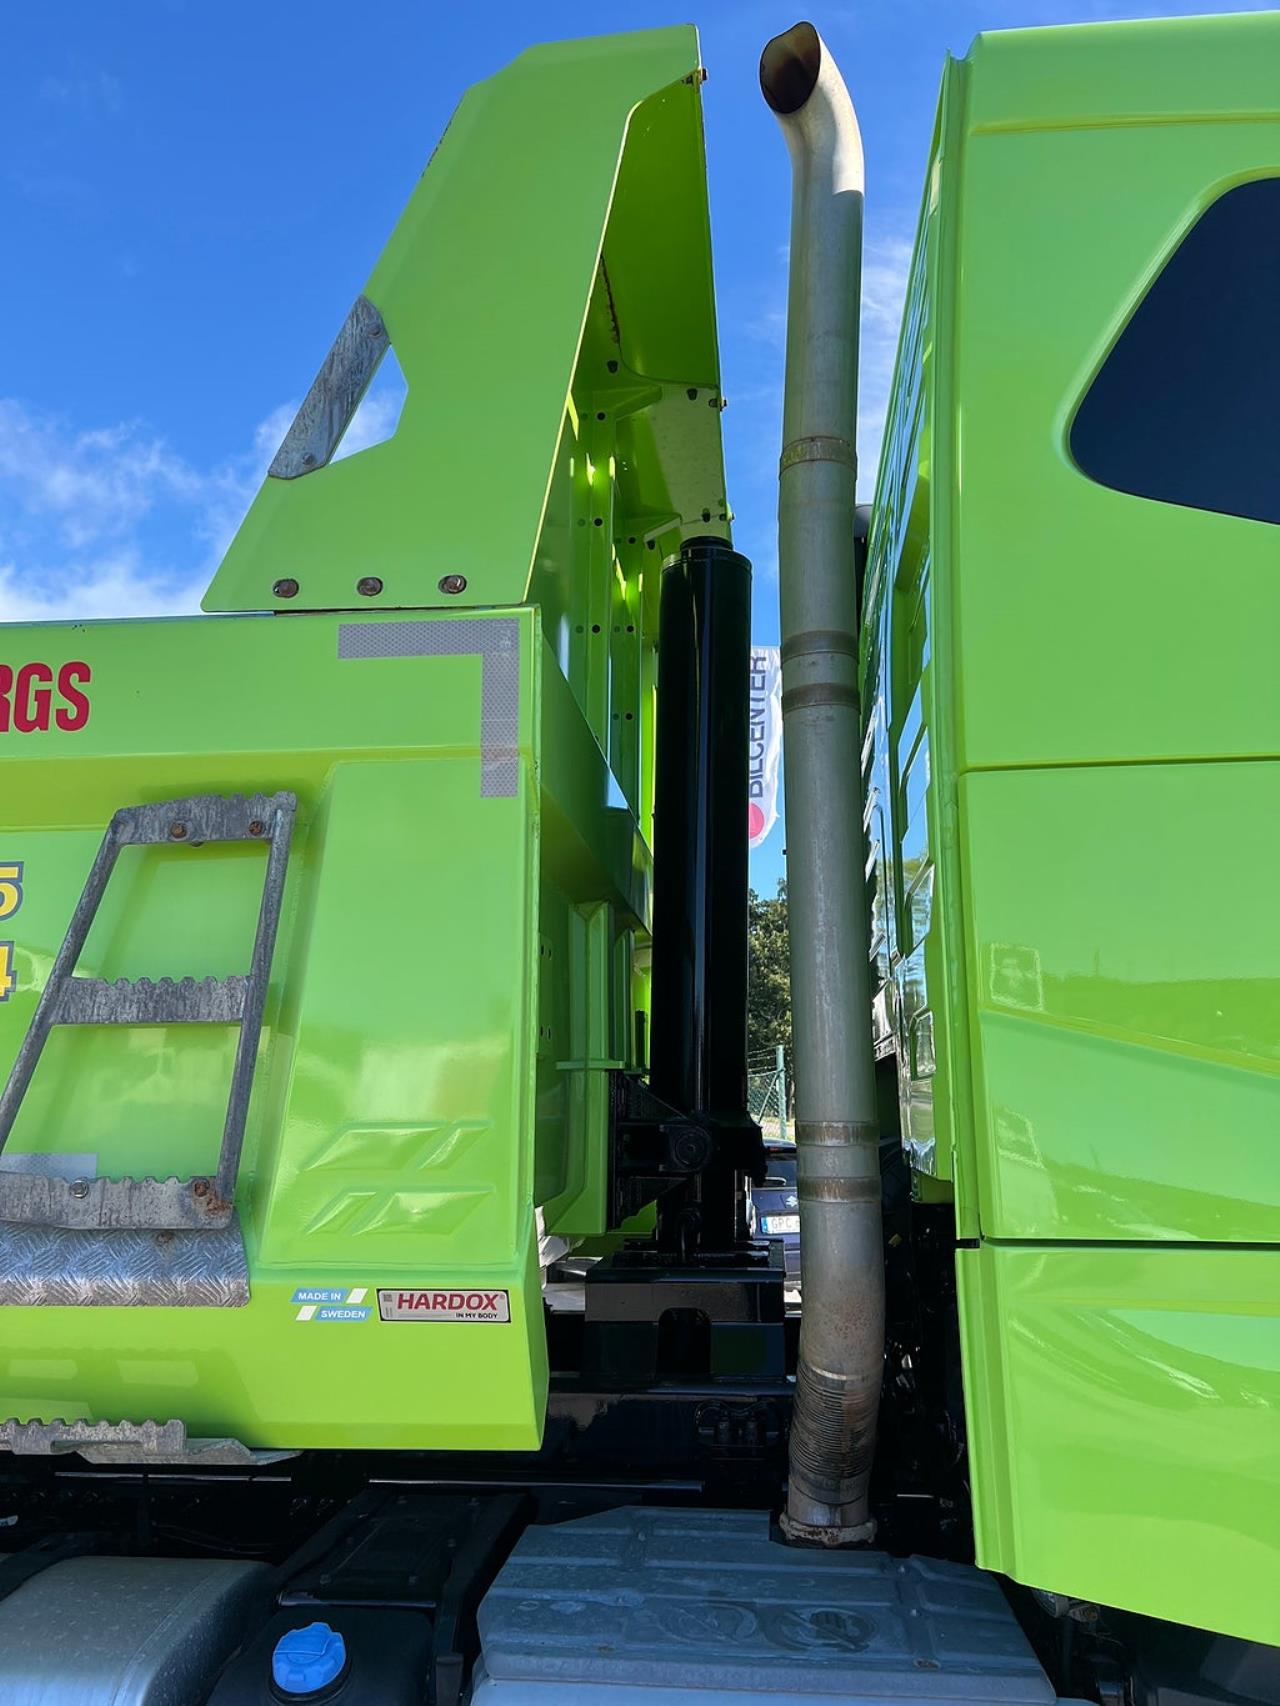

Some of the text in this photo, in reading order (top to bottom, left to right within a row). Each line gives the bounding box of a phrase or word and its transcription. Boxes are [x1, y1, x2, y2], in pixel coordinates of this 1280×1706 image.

[298, 1292, 342, 1300] MADE IN
[397, 1292, 499, 1311] HARDOX
[320, 1310, 366, 1318] SWEDEN
